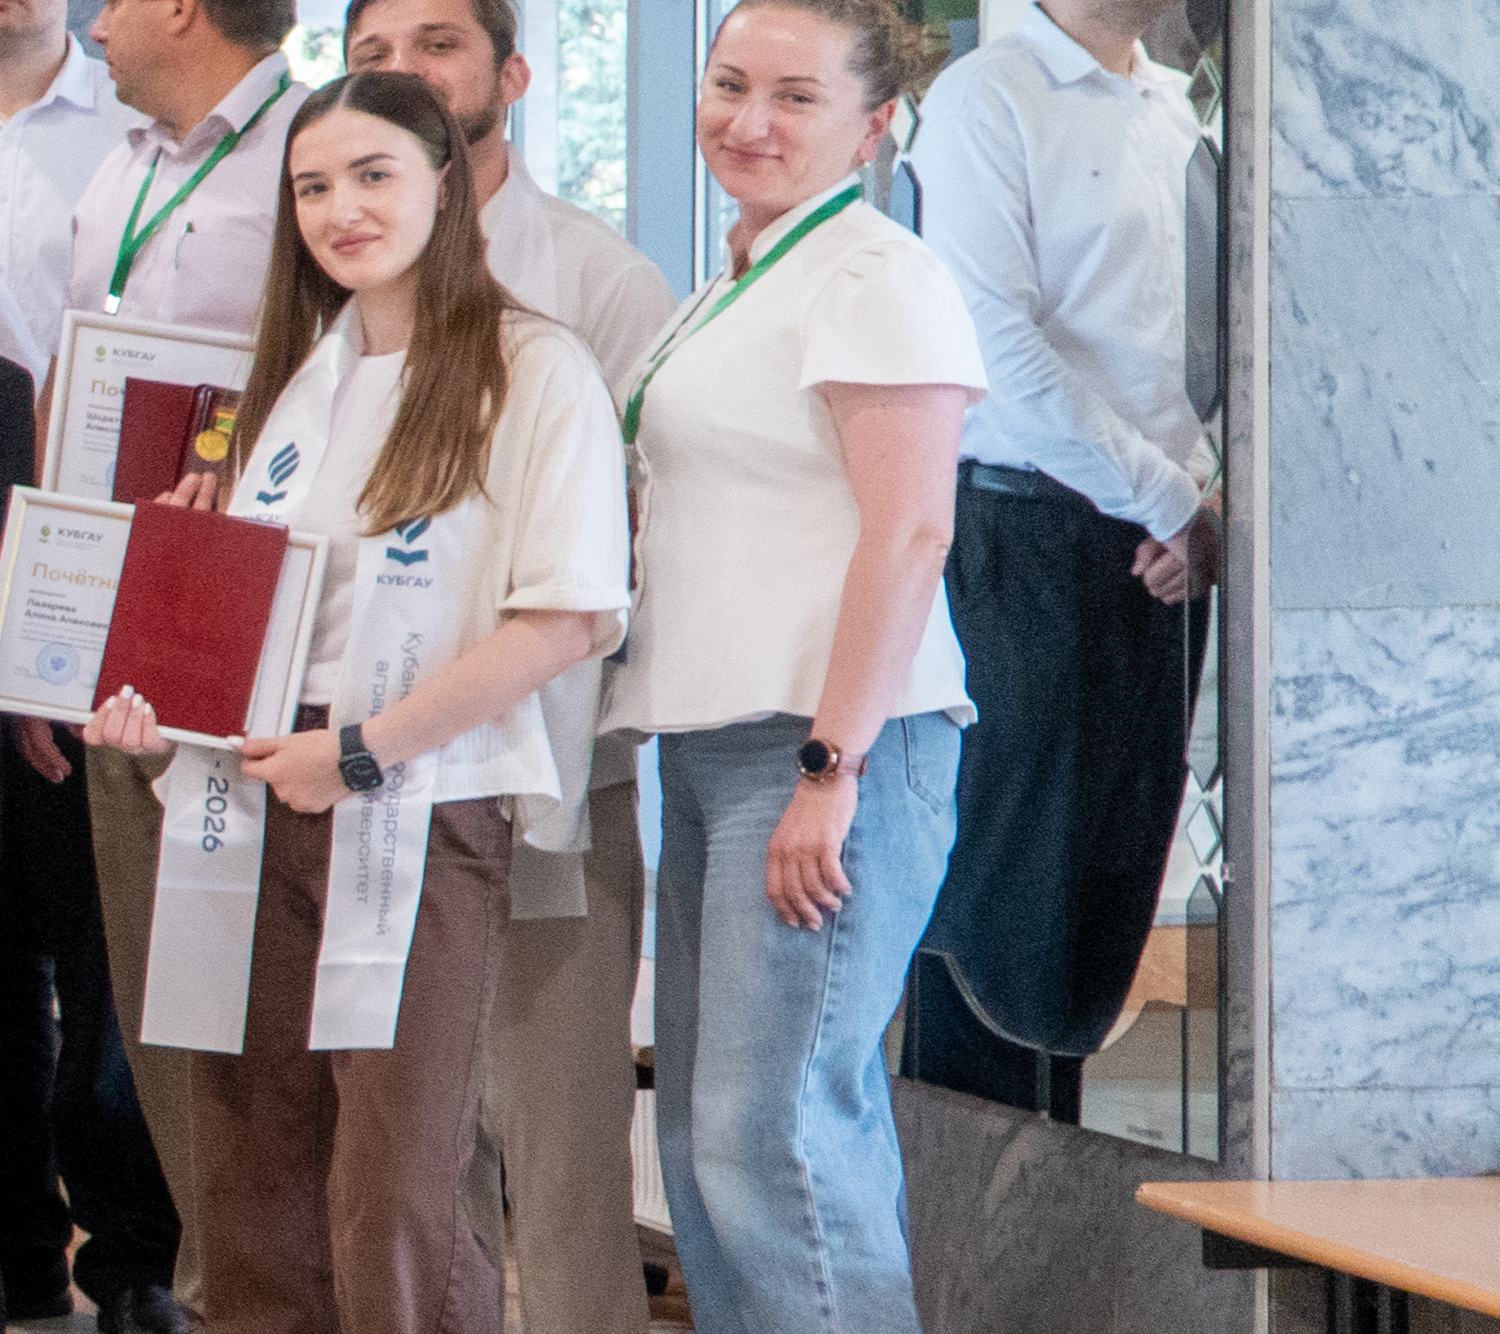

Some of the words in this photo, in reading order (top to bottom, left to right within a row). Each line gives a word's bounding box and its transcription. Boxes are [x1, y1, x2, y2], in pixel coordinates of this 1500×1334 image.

[32, 562, 119, 591] Почётн
[376, 573, 433, 588] КУБГАУ
[400, 632, 423, 700] Кубан
[202, 776, 229, 852] 2026
[376, 761, 406, 935] осударственный
